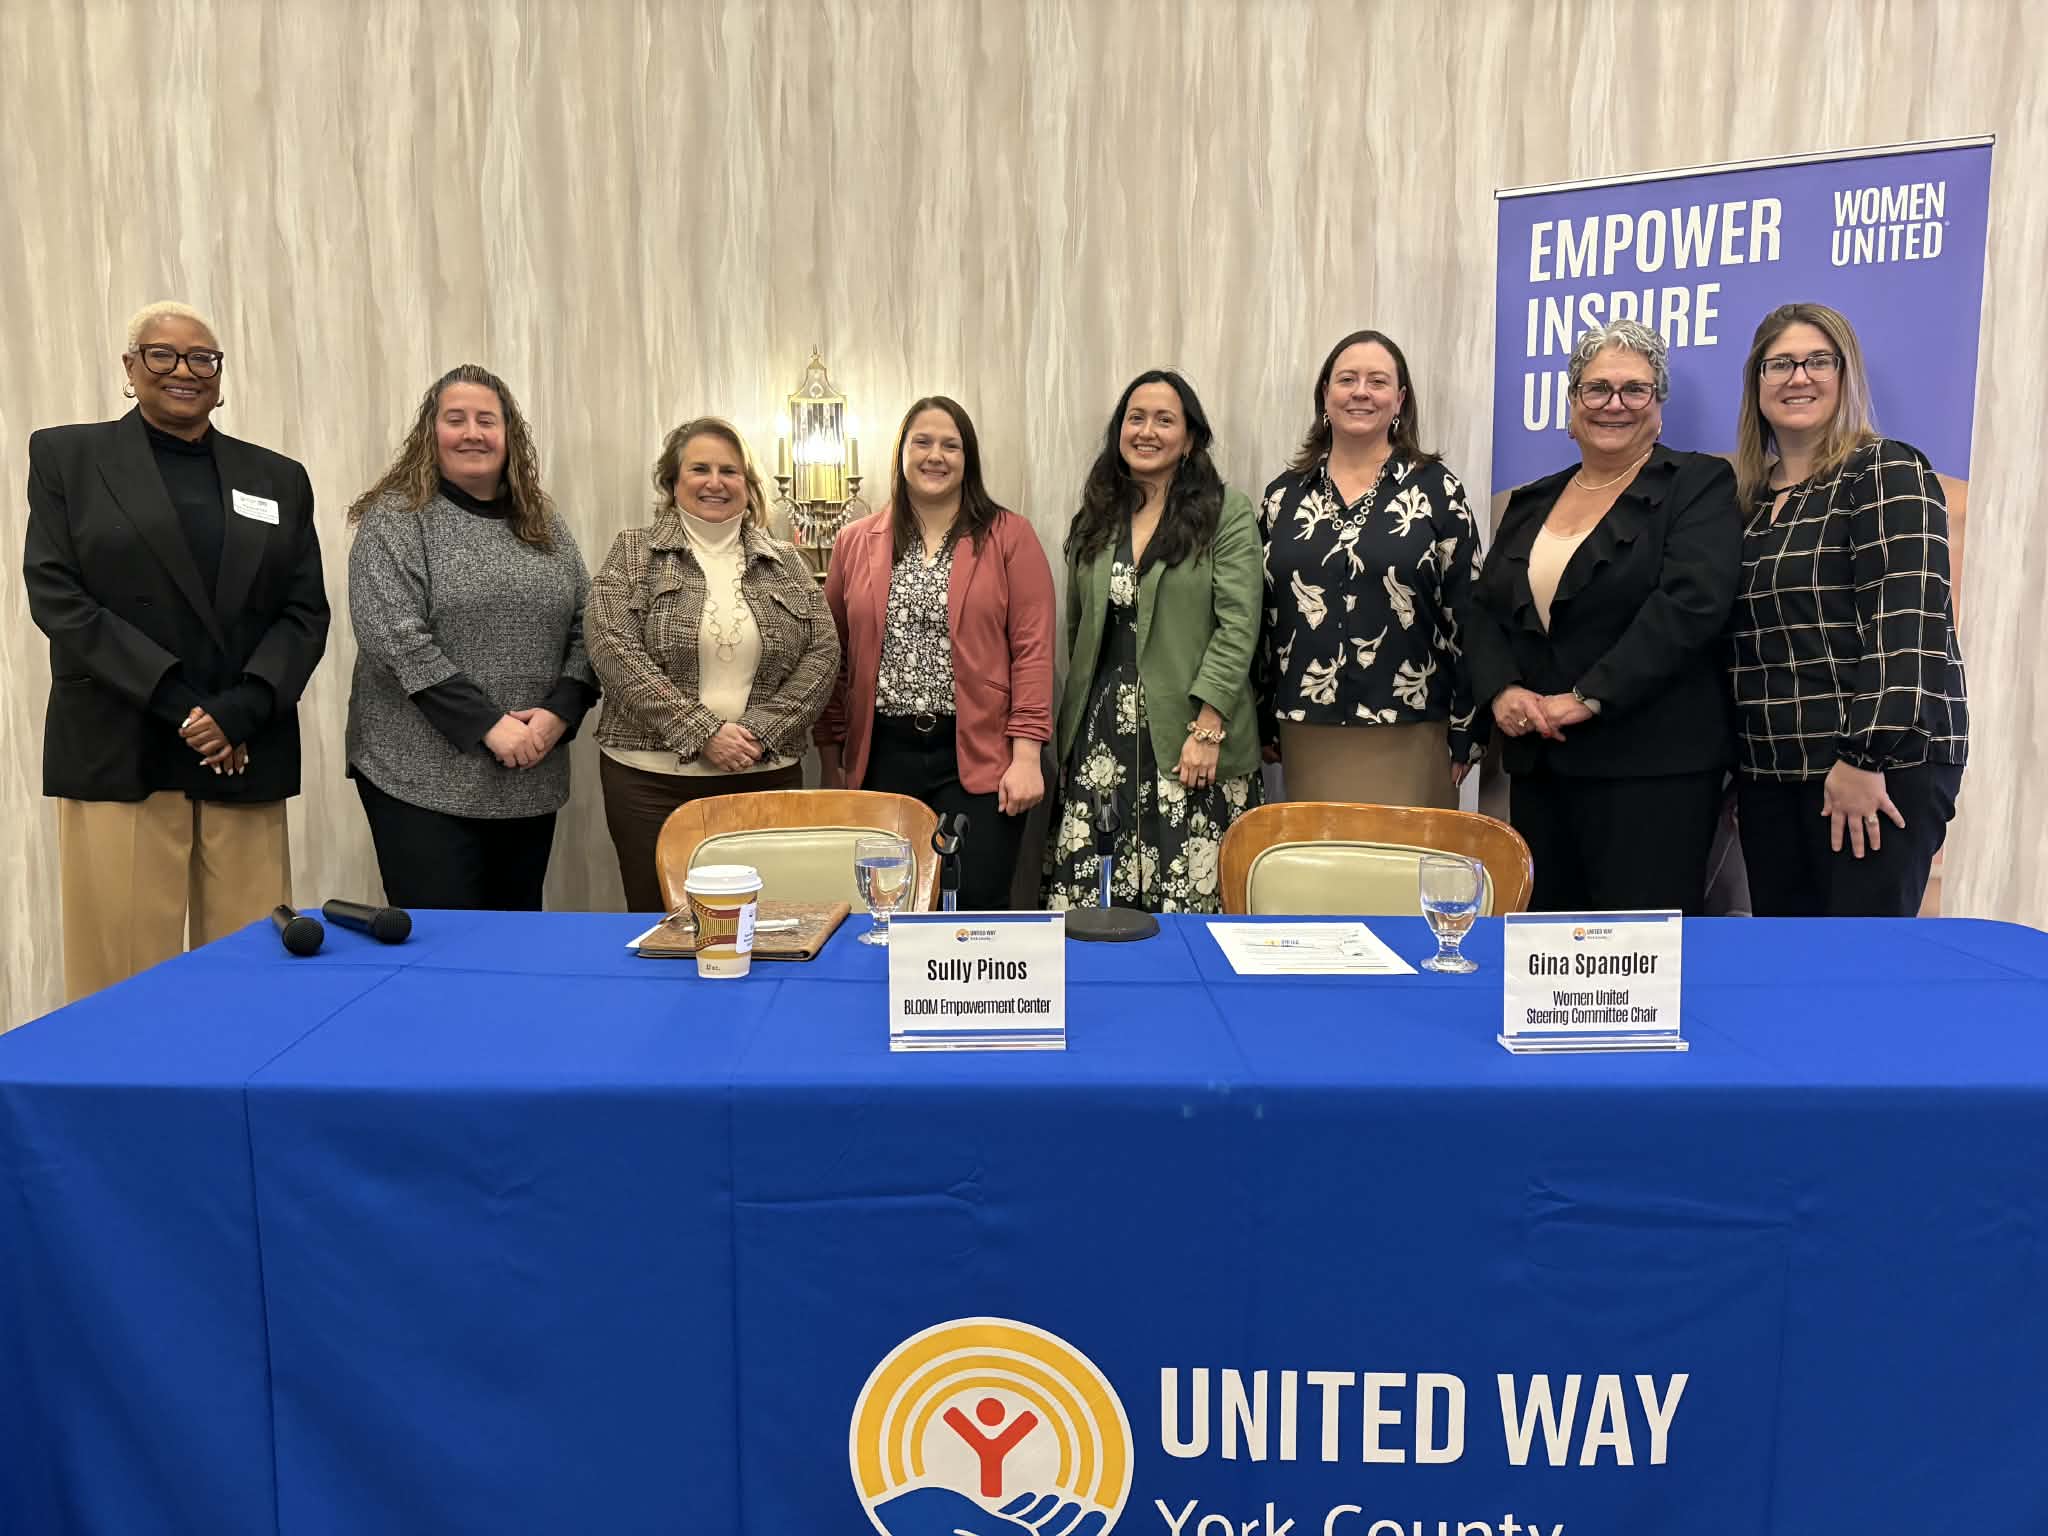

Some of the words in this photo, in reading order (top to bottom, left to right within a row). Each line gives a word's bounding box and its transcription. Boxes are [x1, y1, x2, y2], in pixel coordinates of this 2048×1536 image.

[1834, 181, 1946, 227] WOMEN
[1529, 197, 1783, 283] EMPOWER
[1831, 221, 1943, 267] UNITED
[1526, 282, 1721, 358] INSPIRE
[927, 959, 972, 984] Sully
[977, 957, 1028, 981] Pinos
[1529, 953, 1569, 976] Gina
[1575, 952, 1658, 978] Spangler
[904, 998, 938, 1015] BLOOM
[940, 998, 1015, 1017] Empowerment
[1017, 997, 1052, 1014] Center
[1553, 990, 1594, 1006] Women
[1596, 989, 1629, 1005] United
[1526, 1007, 1569, 1026] Steering
[1571, 1006, 1628, 1024] Committee
[1631, 1006, 1658, 1023] Chair
[1160, 1367, 1464, 1465] UNITED
[1497, 1372, 1689, 1467] WAY
